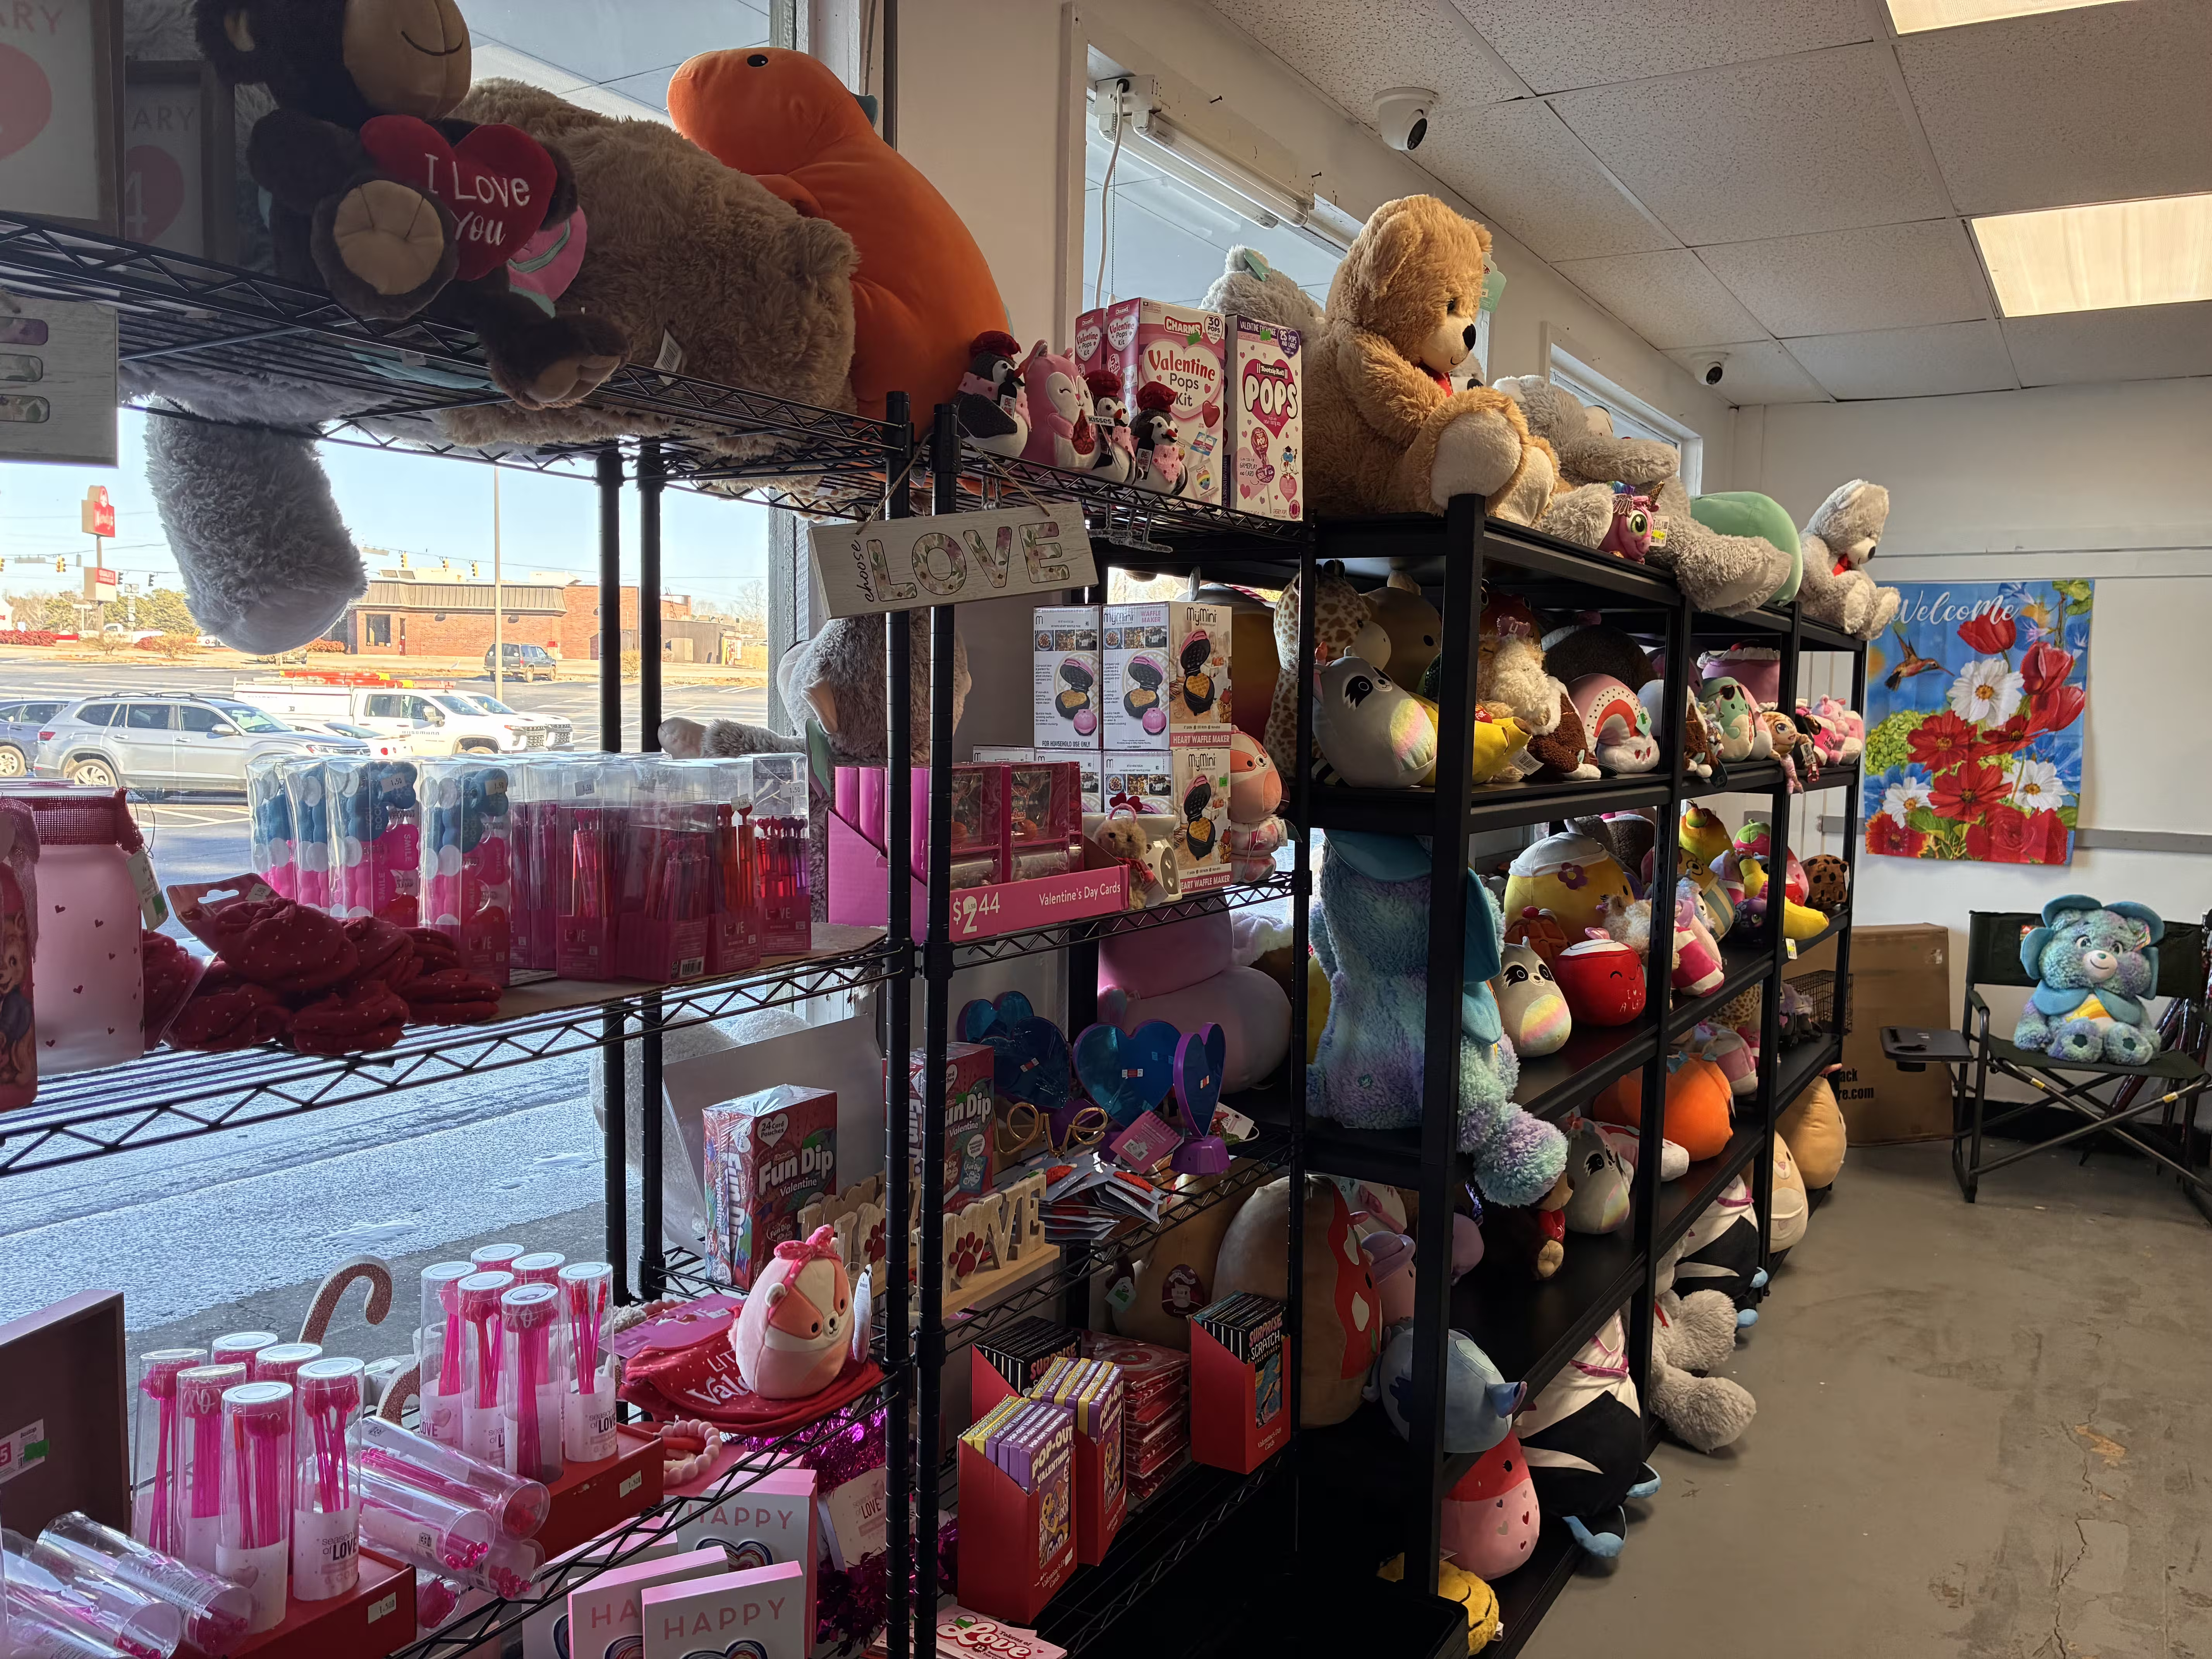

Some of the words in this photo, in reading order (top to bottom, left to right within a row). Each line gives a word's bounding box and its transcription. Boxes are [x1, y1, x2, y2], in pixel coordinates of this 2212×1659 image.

[425, 153, 438, 194] I
[452, 161, 530, 207] Love
[447, 211, 506, 246] You
[1109, 321, 1135, 335] Valentine
[1166, 318, 1201, 336] CHARMS
[1208, 316, 1220, 327] 30
[1240, 321, 1259, 332] VALENTINE
[1077, 332, 1098, 345] Valentine
[1280, 330, 1287, 341] 25
[1288, 335, 1297, 344] POPS
[1110, 355, 1116, 365] 5
[1148, 350, 1215, 381] Valentine
[1170, 373, 1199, 392] Pops
[1176, 392, 1193, 407] Kit
[1245, 373, 1298, 419] POPS
[851, 540, 874, 602] choose
[866, 521, 1070, 602] LOVE
[1894, 590, 2020, 625] Welcome
[1192, 735, 1211, 744] WAFFLE
[391, 777, 402, 786] 1.50
[582, 784, 592, 792] 1.50
[404, 833, 412, 862] SMILE
[1181, 881, 1194, 890] EART
[1194, 878, 1213, 888] WAFFLE
[1213, 874, 1230, 884] MAKER
[1039, 888, 1082, 906] Valentine's
[1084, 886, 1098, 900] Day
[1100, 881, 1121, 895] Cards
[766, 907, 790, 920] LVE
[565, 929, 586, 942] LVE
[725, 921, 744, 937] LVE
[1839, 1068, 1858, 1082] ack
[1838, 1087, 1874, 1100] re.com
[945, 1102, 964, 1125] un
[967, 1092, 992, 1123] Dip
[761, 1121, 771, 1130] 24
[772, 1121, 784, 1129] Card
[761, 1127, 784, 1138] Pouches
[950, 1121, 978, 1137] Valentine
[723, 1152, 741, 1203] Fun
[758, 1155, 798, 1194] Fun
[801, 1143, 834, 1180] Dip
[780, 1177, 817, 1197] Valentine
[715, 1177, 725, 1228] Valentine
[1249, 1313, 1283, 1348] SURPRISE
[1251, 1329, 1280, 1360] SCRATCH
[589, 1408, 613, 1421] season
[1100, 1380, 1123, 1429] POP-OUT
[598, 1412, 616, 1433] LOVE
[994, 1422, 1013, 1439] POP-OUT
[1011, 1404, 1035, 1427] VALENTINES
[1007, 1424, 1025, 1441] POP-OUT
[1024, 1406, 1047, 1429] VALENTINES
[1018, 1426, 1036, 1443] POP-OUT
[1035, 1408, 1058, 1431] VALENTINES
[1029, 1430, 1047, 1448] POP-OUT
[1045, 1413, 1068, 1435] VALENTINES
[1032, 1425, 1073, 1479] POP-OUT
[1037, 1447, 1069, 1484] VALENTINES
[688, 1503, 793, 1530] HAPPY
[861, 1498, 881, 1519] LOVE
[322, 1531, 353, 1546] season
[323, 1546, 332, 1555] of
[333, 1536, 357, 1561] LOVE
[664, 1597, 786, 1640] HAPPY
[936, 1614, 1032, 1659] Love
[999, 1630, 1023, 1643] Tokens
